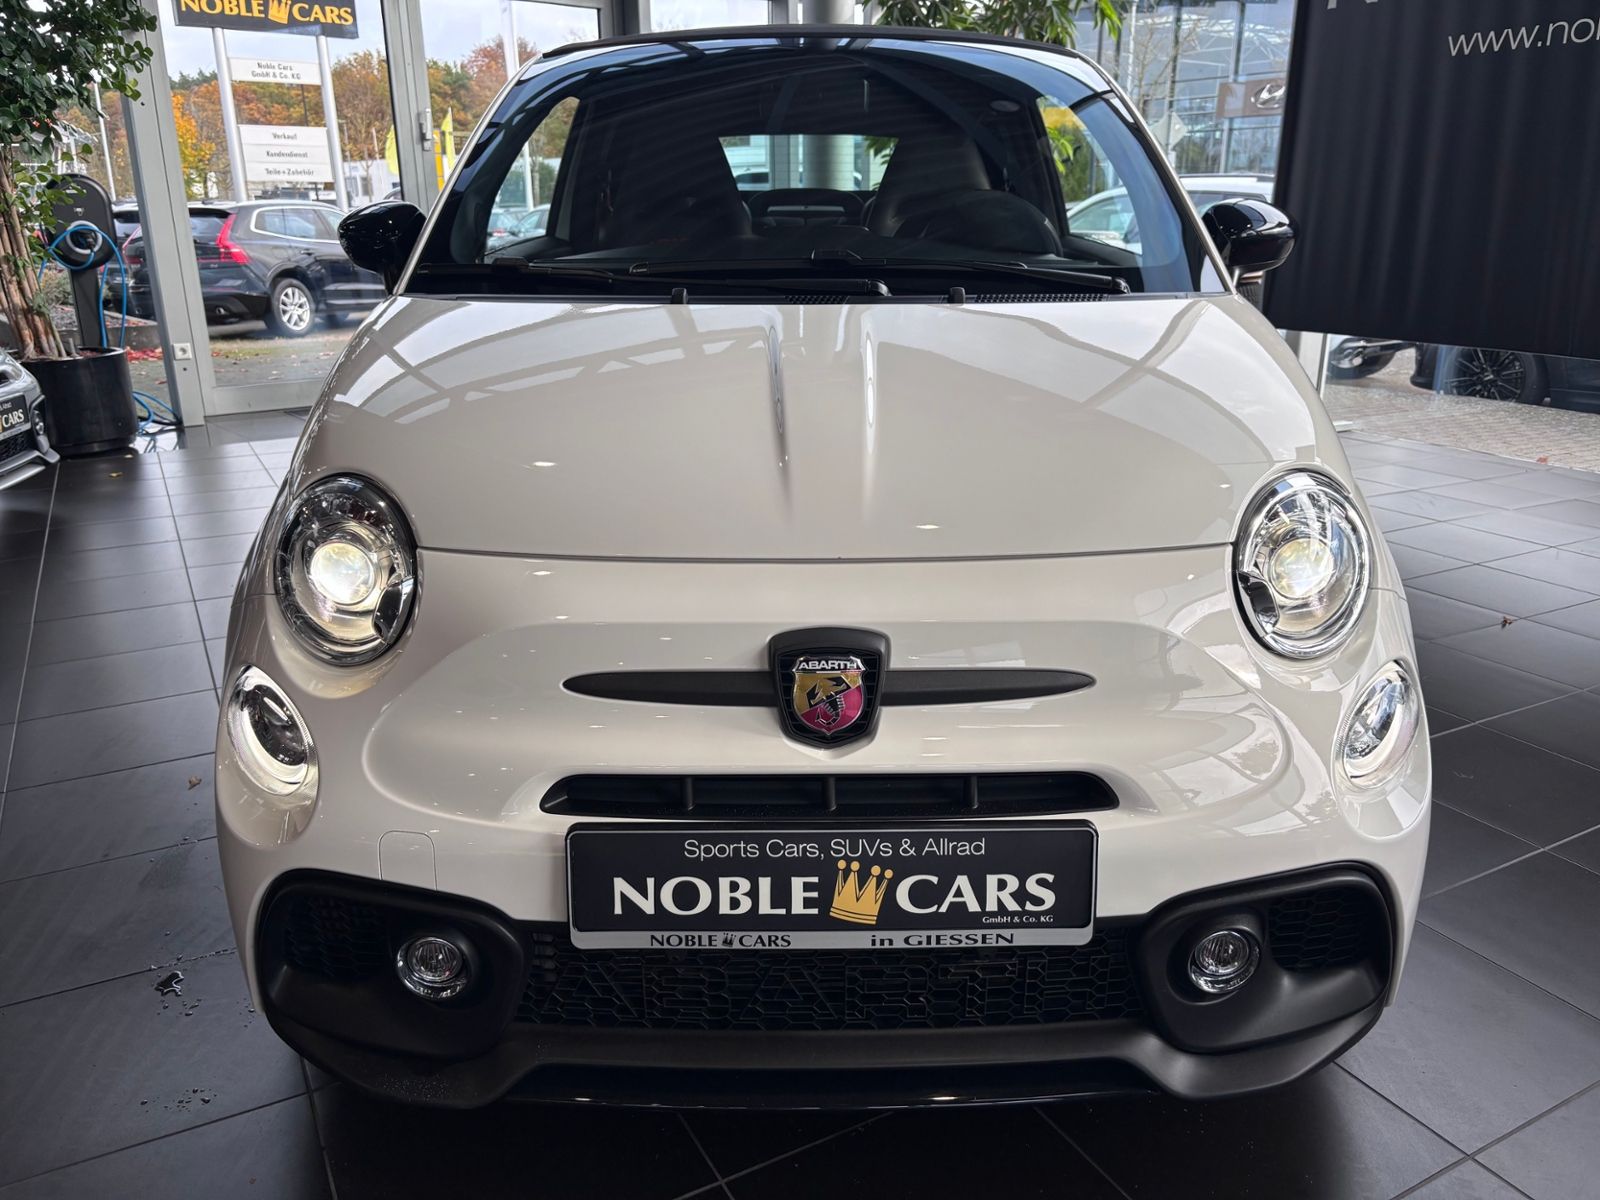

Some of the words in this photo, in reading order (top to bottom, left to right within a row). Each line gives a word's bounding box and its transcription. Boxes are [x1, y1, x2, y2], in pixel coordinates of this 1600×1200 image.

[180, 0, 265, 17] NOBLE
[292, 4, 354, 25] CARS
[1448, 17, 1600, 57] www.no
[257, 62, 276, 70] Noble
[277, 63, 293, 71] Cars
[251, 70, 271, 79] GmbH
[279, 72, 290, 80] Co.
[272, 132, 298, 141] Verkauf
[2, 408, 25, 427] CARS
[799, 660, 857, 670] ABARTH
[684, 839, 760, 861] Sports
[766, 838, 824, 860] Cars,
[830, 838, 892, 857] SUVs
[899, 838, 916, 857] &
[922, 837, 986, 856] Allrad
[613, 876, 819, 916] NOBLE
[895, 873, 1056, 914] CARS
[982, 915, 1011, 924] GmbH
[1013, 915, 1020, 923] &
[1023, 915, 1037, 923] Co.
[1040, 914, 1054, 923] KG
[650, 934, 718, 948] NOBLE
[738, 934, 791, 948] CARS
[870, 935, 893, 947] in
[903, 933, 1014, 946] GIESSEN
